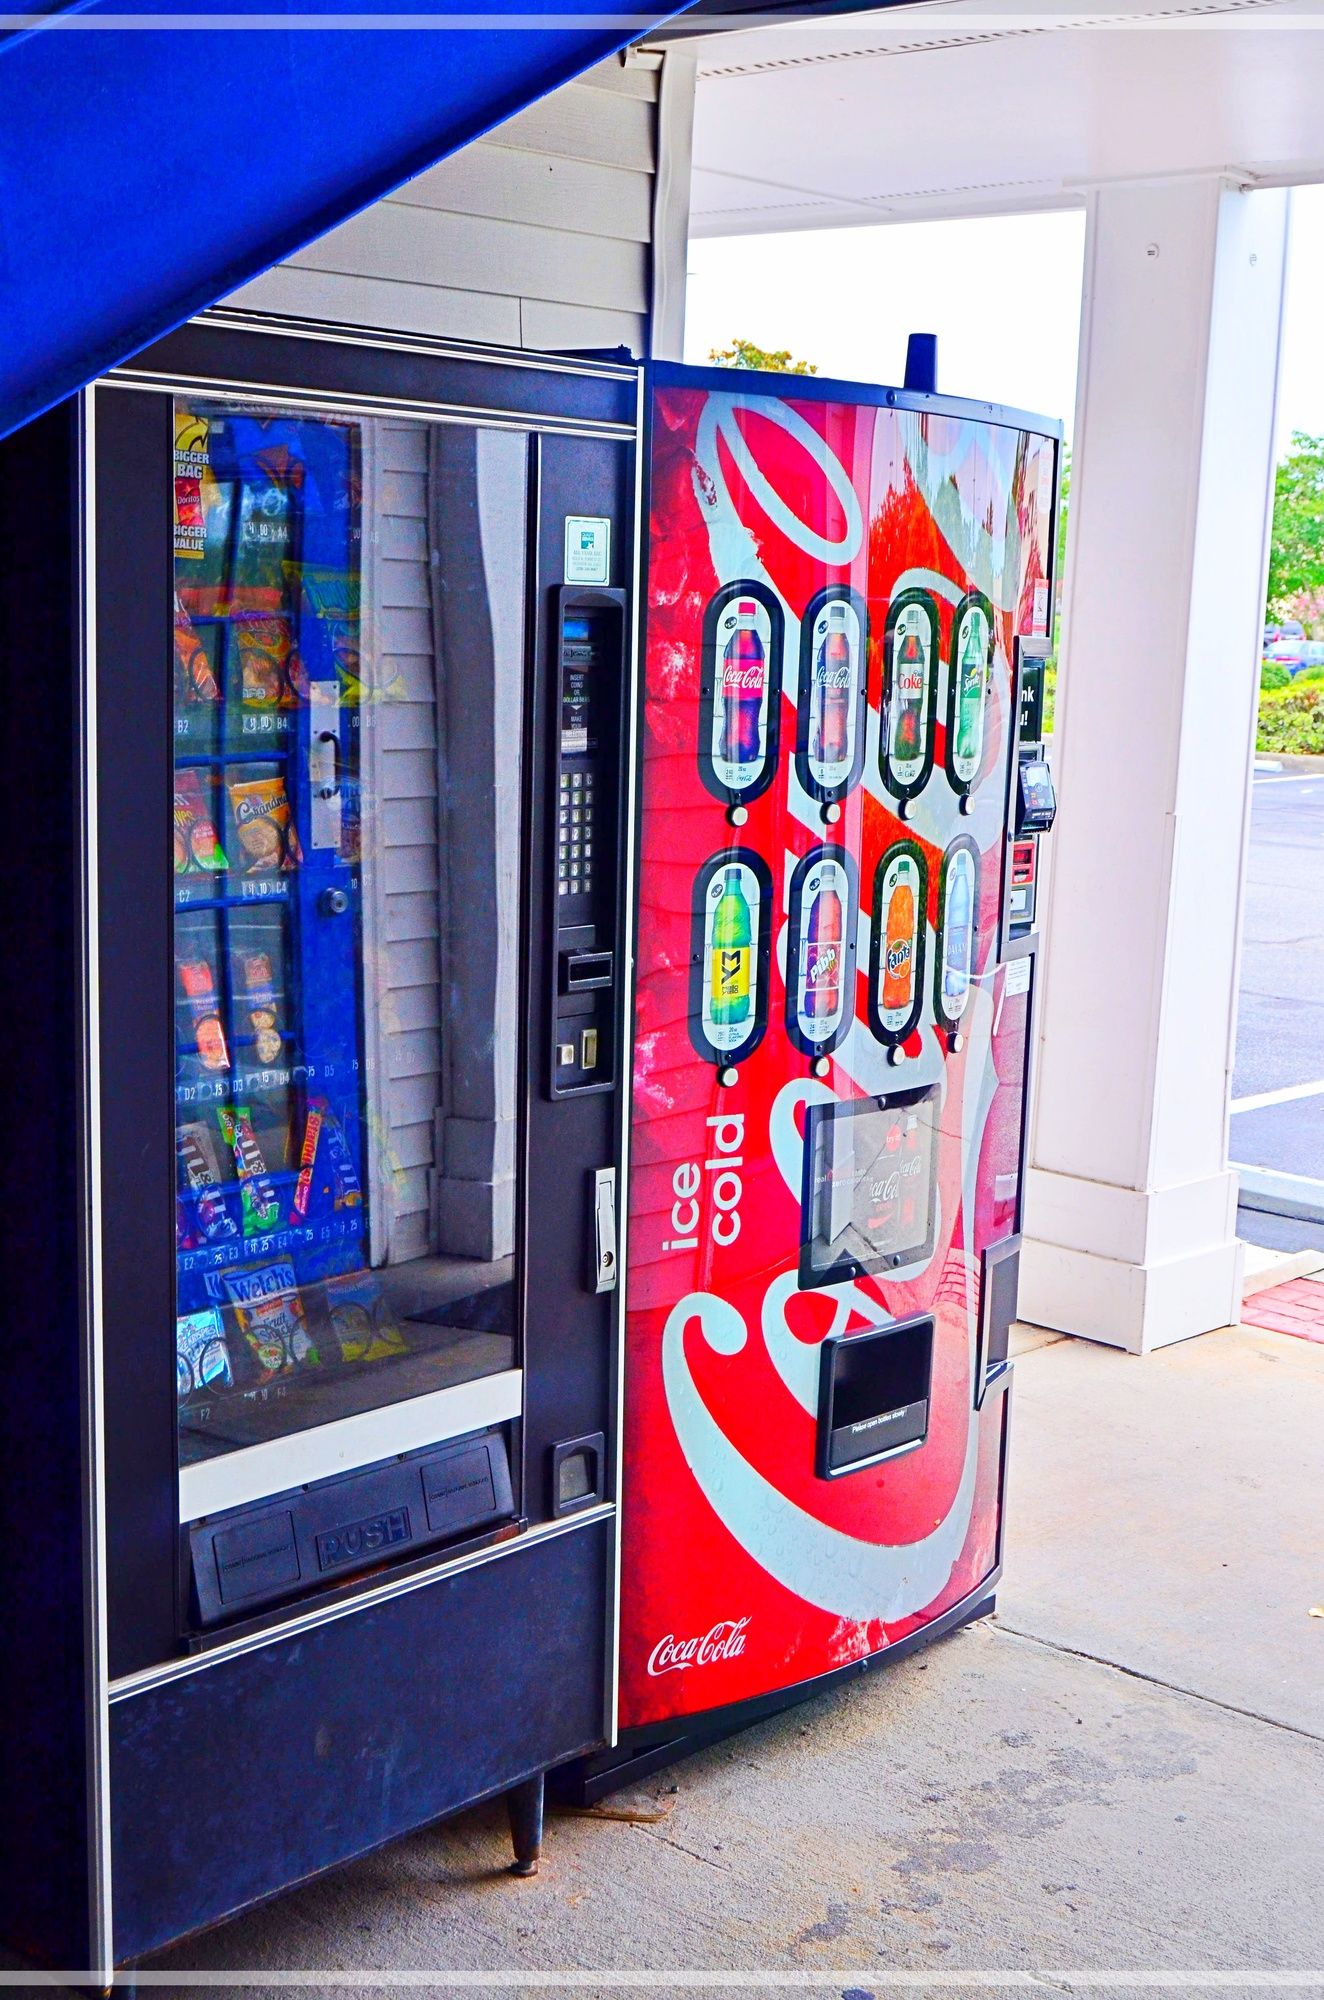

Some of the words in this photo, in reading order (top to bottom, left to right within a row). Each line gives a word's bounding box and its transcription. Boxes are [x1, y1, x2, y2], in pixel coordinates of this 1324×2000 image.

[178, 464, 202, 478] BAG
[178, 495, 200, 504] Doritos
[723, 665, 764, 688] Coca-Cola
[817, 666, 851, 688] Coca-Cola
[898, 674, 923, 690] Coke
[964, 675, 980, 692] Sprite
[178, 720, 189, 734] B2
[277, 718, 288, 730] B4
[179, 890, 190, 903] C2
[276, 882, 287, 894] C4
[811, 948, 836, 984] Pibb
[888, 944, 910, 971] Fanta
[185, 1088, 196, 1100] D2
[233, 1079, 244, 1092] D3
[325, 1064, 334, 1077] D5
[705, 1114, 744, 1246] cold
[662, 1162, 700, 1250] ice
[184, 1256, 194, 1270] E2
[229, 1247, 239, 1260] E3
[278, 1235, 288, 1248] E4
[321, 1226, 330, 1239] E5
[232, 1264, 295, 1300] Welch's
[263, 1314, 287, 1328] Fruit
[201, 1408, 210, 1422] F2
[867, 1419, 878, 1428] open
[878, 1414, 892, 1424] bottles
[321, 1510, 407, 1571] PUSH
[648, 1616, 752, 1676] Coca-Cola
